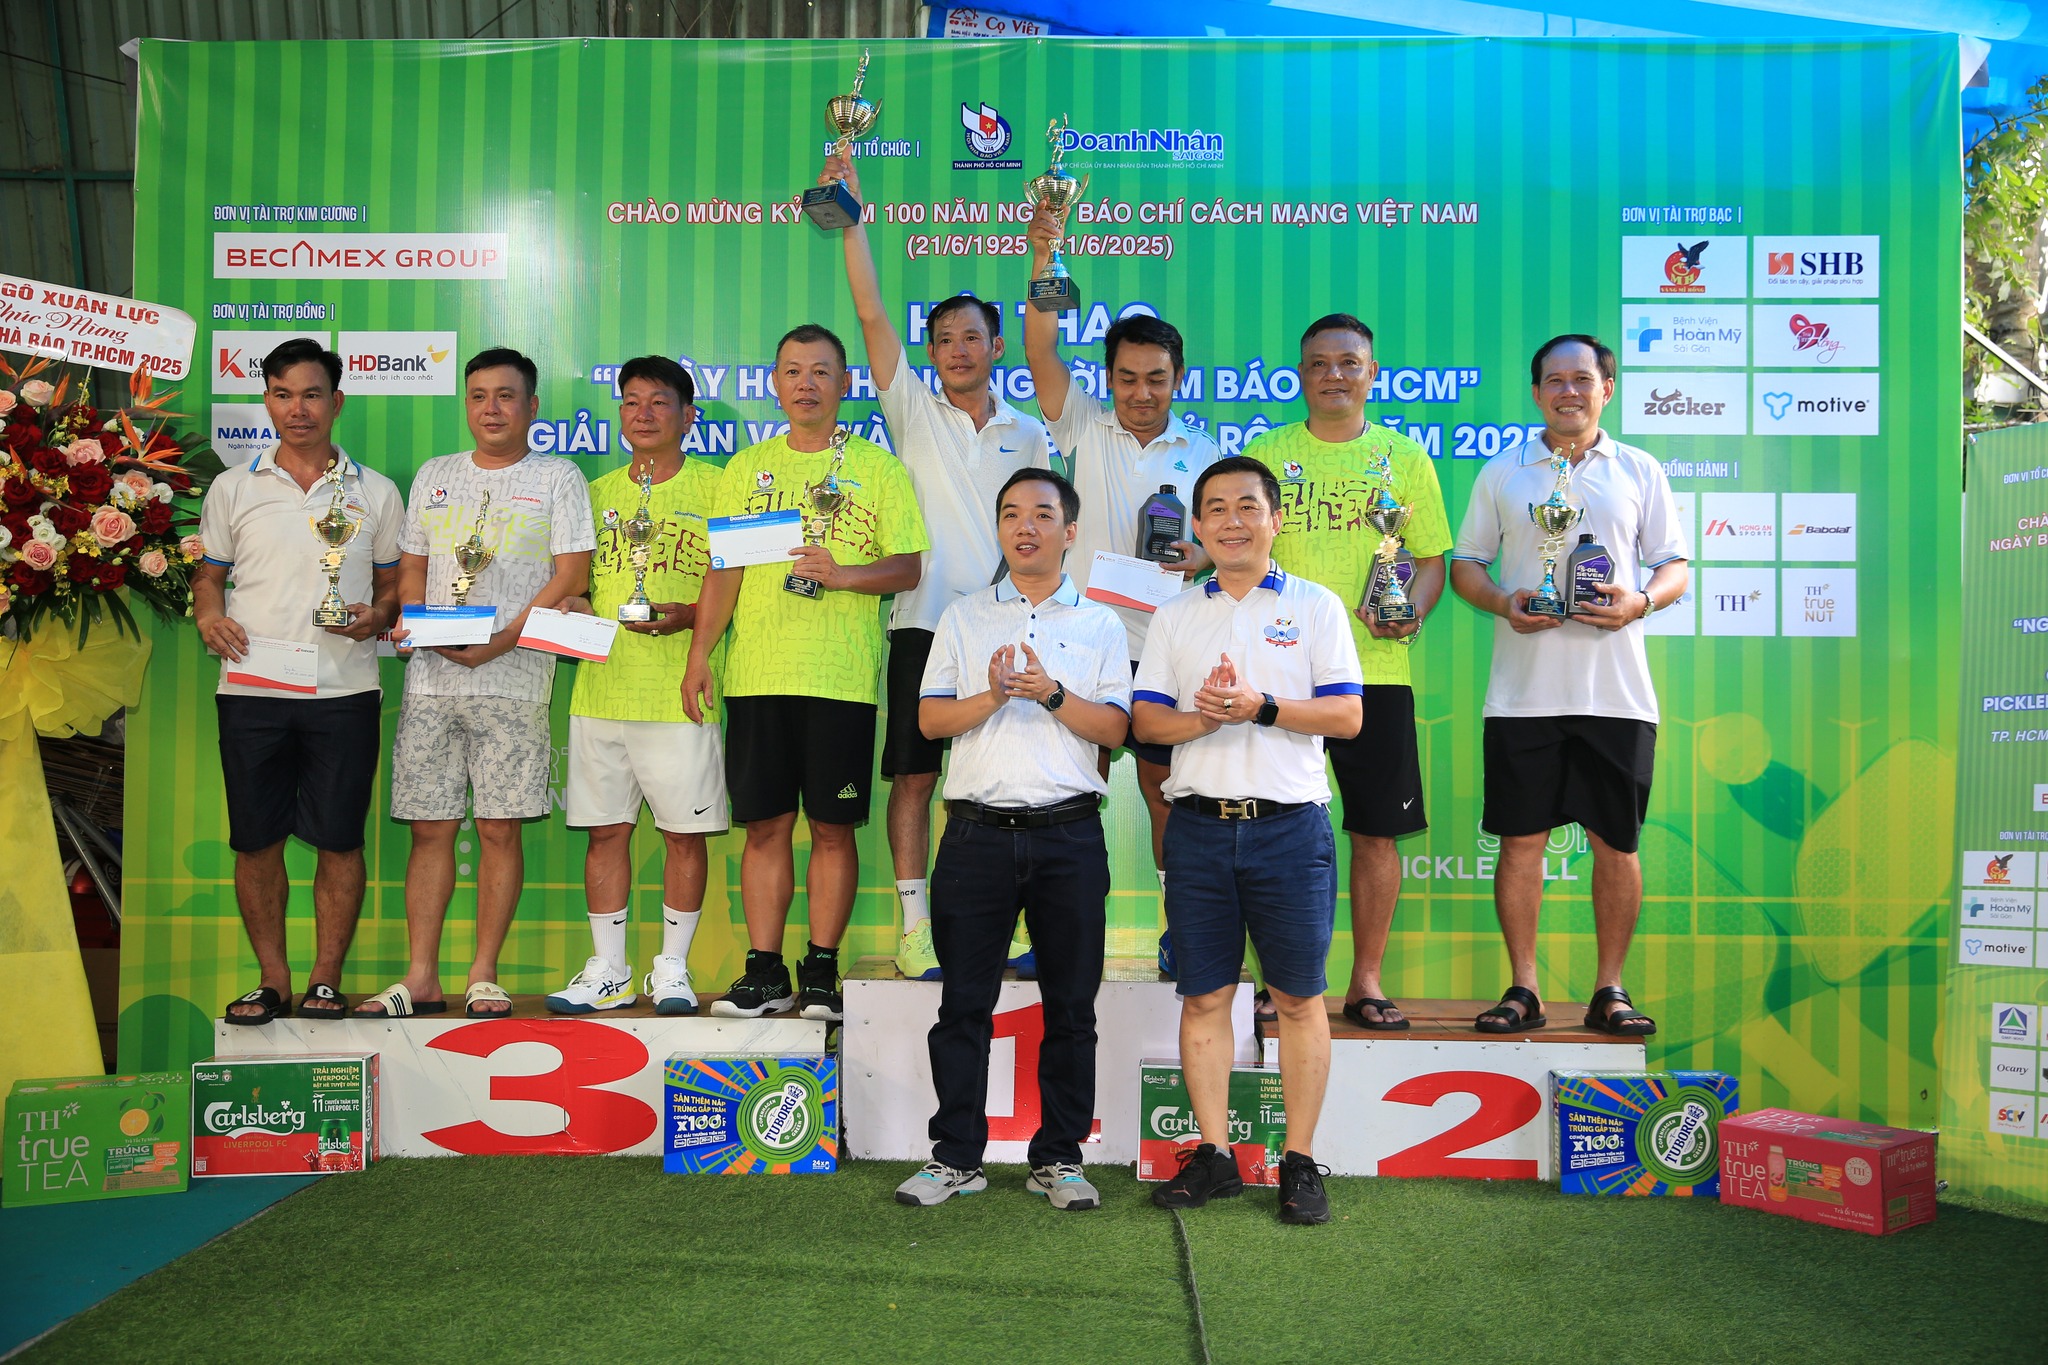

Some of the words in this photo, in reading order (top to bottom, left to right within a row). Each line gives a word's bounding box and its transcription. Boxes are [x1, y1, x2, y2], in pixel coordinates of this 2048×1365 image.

[864, 136, 878, 156] TỔ
[882, 139, 911, 157] CHỨC
[1063, 129, 1223, 151] DoanhNhân
[974, 160, 984, 168] PHỐ
[214, 205, 236, 221] ĐƠN
[239, 205, 250, 224] VỊ
[253, 202, 270, 221] TÀI
[273, 205, 294, 224] TRỢ
[297, 206, 318, 221] KIM
[320, 205, 357, 221] CƯƠNG
[608, 198, 680, 224] CHÀO
[687, 198, 762, 224] MỪNG
[771, 196, 803, 224] KỶ
[885, 203, 926, 224] 100
[933, 198, 989, 224] NĂM
[1078, 197, 1132, 223] BÁO
[1139, 197, 1183, 223] CHÍ
[1191, 197, 1263, 223] CÁCH
[1272, 203, 1349, 227] MẠNG
[1356, 197, 1414, 227] VIỆT
[1421, 203, 1479, 223] NAM
[1622, 207, 1646, 222] ĐƠN
[1649, 207, 1661, 225] VỊ
[1663, 204, 1681, 222] TÀI
[1684, 207, 1707, 225] TRỢ
[1709, 207, 1732, 225] BẠC
[907, 234, 1028, 260] (21/6/1925
[396, 249, 497, 267] GROUP
[1800, 252, 1863, 275] SHB
[41, 290, 108, 315] XUÂN
[115, 303, 160, 325] LỰC
[213, 304, 235, 319] ĐƠN
[239, 304, 249, 322] VỊ
[252, 302, 269, 319] TÀI
[272, 304, 293, 322] TRỢ
[296, 300, 325, 319] ĐỒNG
[46, 311, 129, 344] Mừng
[1673, 317, 1695, 326] Bệnh
[1698, 317, 1718, 326] Viện
[1673, 328, 1715, 342] Hoàn
[1719, 328, 1742, 344] Mỹ
[1673, 344, 1688, 353] Sài
[1691, 344, 1710, 353] Gòn
[71, 340, 135, 366] TP.HCM
[141, 354, 183, 376] 2025
[349, 355, 427, 372] HDBank
[1217, 360, 1300, 399] BÁO
[1644, 397, 1726, 415] zocker
[1798, 397, 1867, 413] motive
[218, 428, 258, 439] NAM
[527, 411, 607, 452] GIẢI
[1663, 458, 1693, 477] ĐỒNG
[1696, 460, 1728, 477] HÀNH
[2003, 473, 2019, 484] ĐƠN
[2020, 471, 2029, 483] VỊ
[1990, 534, 2032, 552] NGÀY
[1805, 586, 1821, 595] TH
[1715, 595, 1748, 611] TH
[1804, 597, 1835, 609] true
[1805, 611, 1835, 622] NUT
[1991, 731, 2010, 742] TP.
[1990, 904, 2015, 912] Hoàn
[2017, 905, 2031, 914] Mỹ
[1984, 943, 2025, 954] motive
[196, 1072, 219, 1081] Carlsberg
[312, 1065, 329, 1074] TRẢI
[330, 1066, 359, 1075] NGHIỆM
[1997, 1064, 2028, 1075] Ocany
[421, 1018, 658, 1156] 3
[312, 1099, 323, 1112] 11
[673, 1104, 697, 1112] TRÚNG
[691, 1096, 710, 1105] THÊM
[18, 1109, 61, 1132] TH
[204, 1101, 306, 1139] Carlsberg
[759, 1099, 776, 1128] COPENHAGEN
[764, 1096, 797, 1142] TUBORG
[1260, 1110, 1270, 1124] 11
[1587, 1115, 1607, 1125] THÊM
[791, 1120, 802, 1137] GREEN
[1377, 1070, 1542, 1179] 2
[1568, 1124, 1594, 1132] TRÚNG
[1659, 1119, 1676, 1149] COPENHAGEN
[1665, 1116, 1697, 1164] TUBORG
[18, 1134, 89, 1162] true
[108, 1144, 150, 1156] TRÚNG
[224, 1140, 274, 1149] LIVERPOOL
[1692, 1141, 1704, 1158] GREEN
[1724, 1140, 1749, 1157] TH
[1900, 1148, 1916, 1162] true
[1725, 1156, 1766, 1180] true
[1787, 1159, 1819, 1170] TRÚNG
[1853, 1167, 1865, 1177] TH
[17, 1159, 89, 1192] TEA
[1725, 1175, 1767, 1201] TEA
